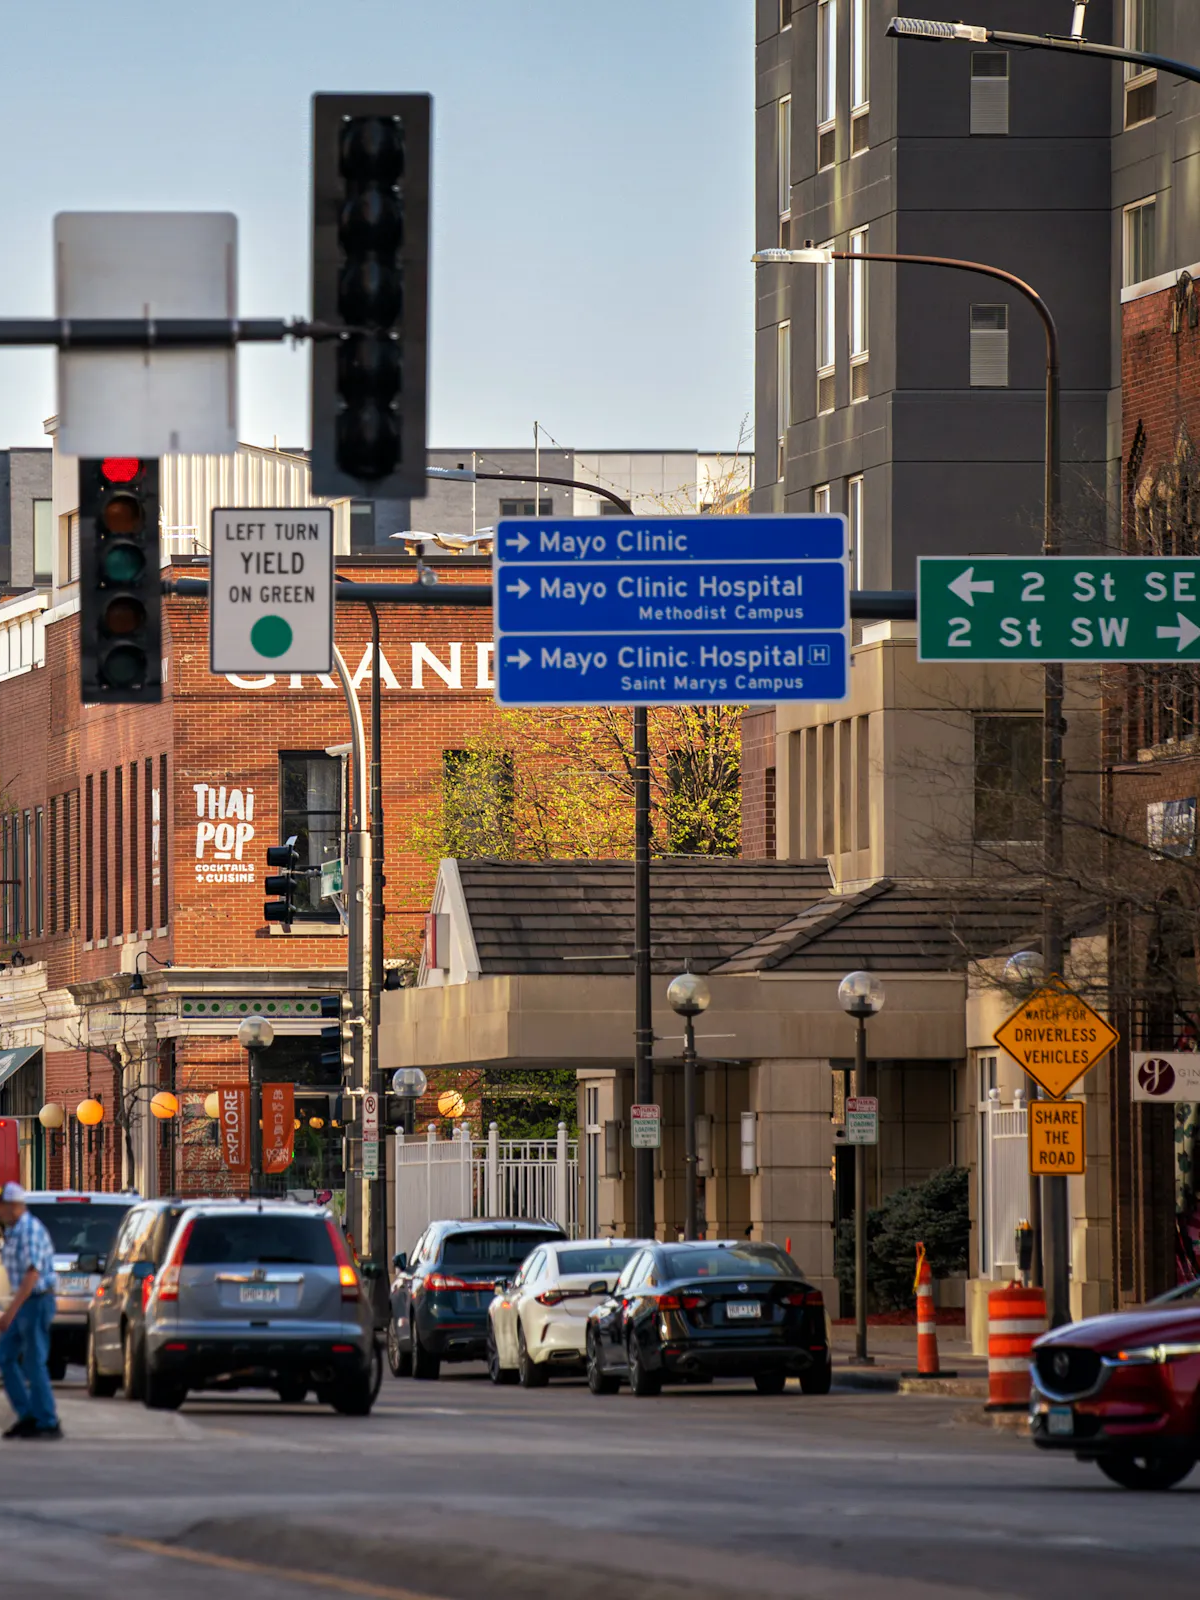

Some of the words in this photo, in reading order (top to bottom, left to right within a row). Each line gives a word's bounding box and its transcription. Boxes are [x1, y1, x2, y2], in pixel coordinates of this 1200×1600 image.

[226, 523, 266, 541] LEFT
[275, 523, 319, 541] TURN
[540, 531, 606, 559] Mayo
[617, 530, 688, 552] Clinic
[240, 552, 305, 575] YIELD
[229, 585, 251, 603] ON
[260, 585, 315, 603] GREEN
[540, 578, 606, 606] Mayo
[617, 576, 688, 598] Clinic
[700, 575, 803, 603] Hospital
[1021, 571, 1046, 602] 2
[1072, 571, 1116, 602] St
[1144, 571, 1196, 602] SE
[639, 606, 727, 620] Methodist
[735, 606, 804, 622] Campus
[947, 617, 972, 647] 2
[999, 617, 1042, 647] St
[1070, 617, 1129, 647] SW
[541, 647, 607, 676] Mayo
[618, 646, 689, 669] Clinic
[700, 645, 804, 673] Hospital
[621, 676, 666, 691] Saint
[674, 676, 727, 694] Marys
[735, 676, 803, 692] Campus
[196, 822, 255, 860] POP
[195, 864, 255, 872] COCKTAILS
[1025, 1009, 1059, 1021] WATCH
[1066, 1009, 1087, 1021] FOR
[1015, 1028, 1097, 1042] DRIVERLESS
[1024, 1050, 1089, 1064] VEHICLES
[1035, 1110, 1079, 1124] SHARE
[224, 1090, 239, 1164] EXPLORE
[1045, 1131, 1069, 1144] THE
[1039, 1151, 1075, 1165] ROAD
